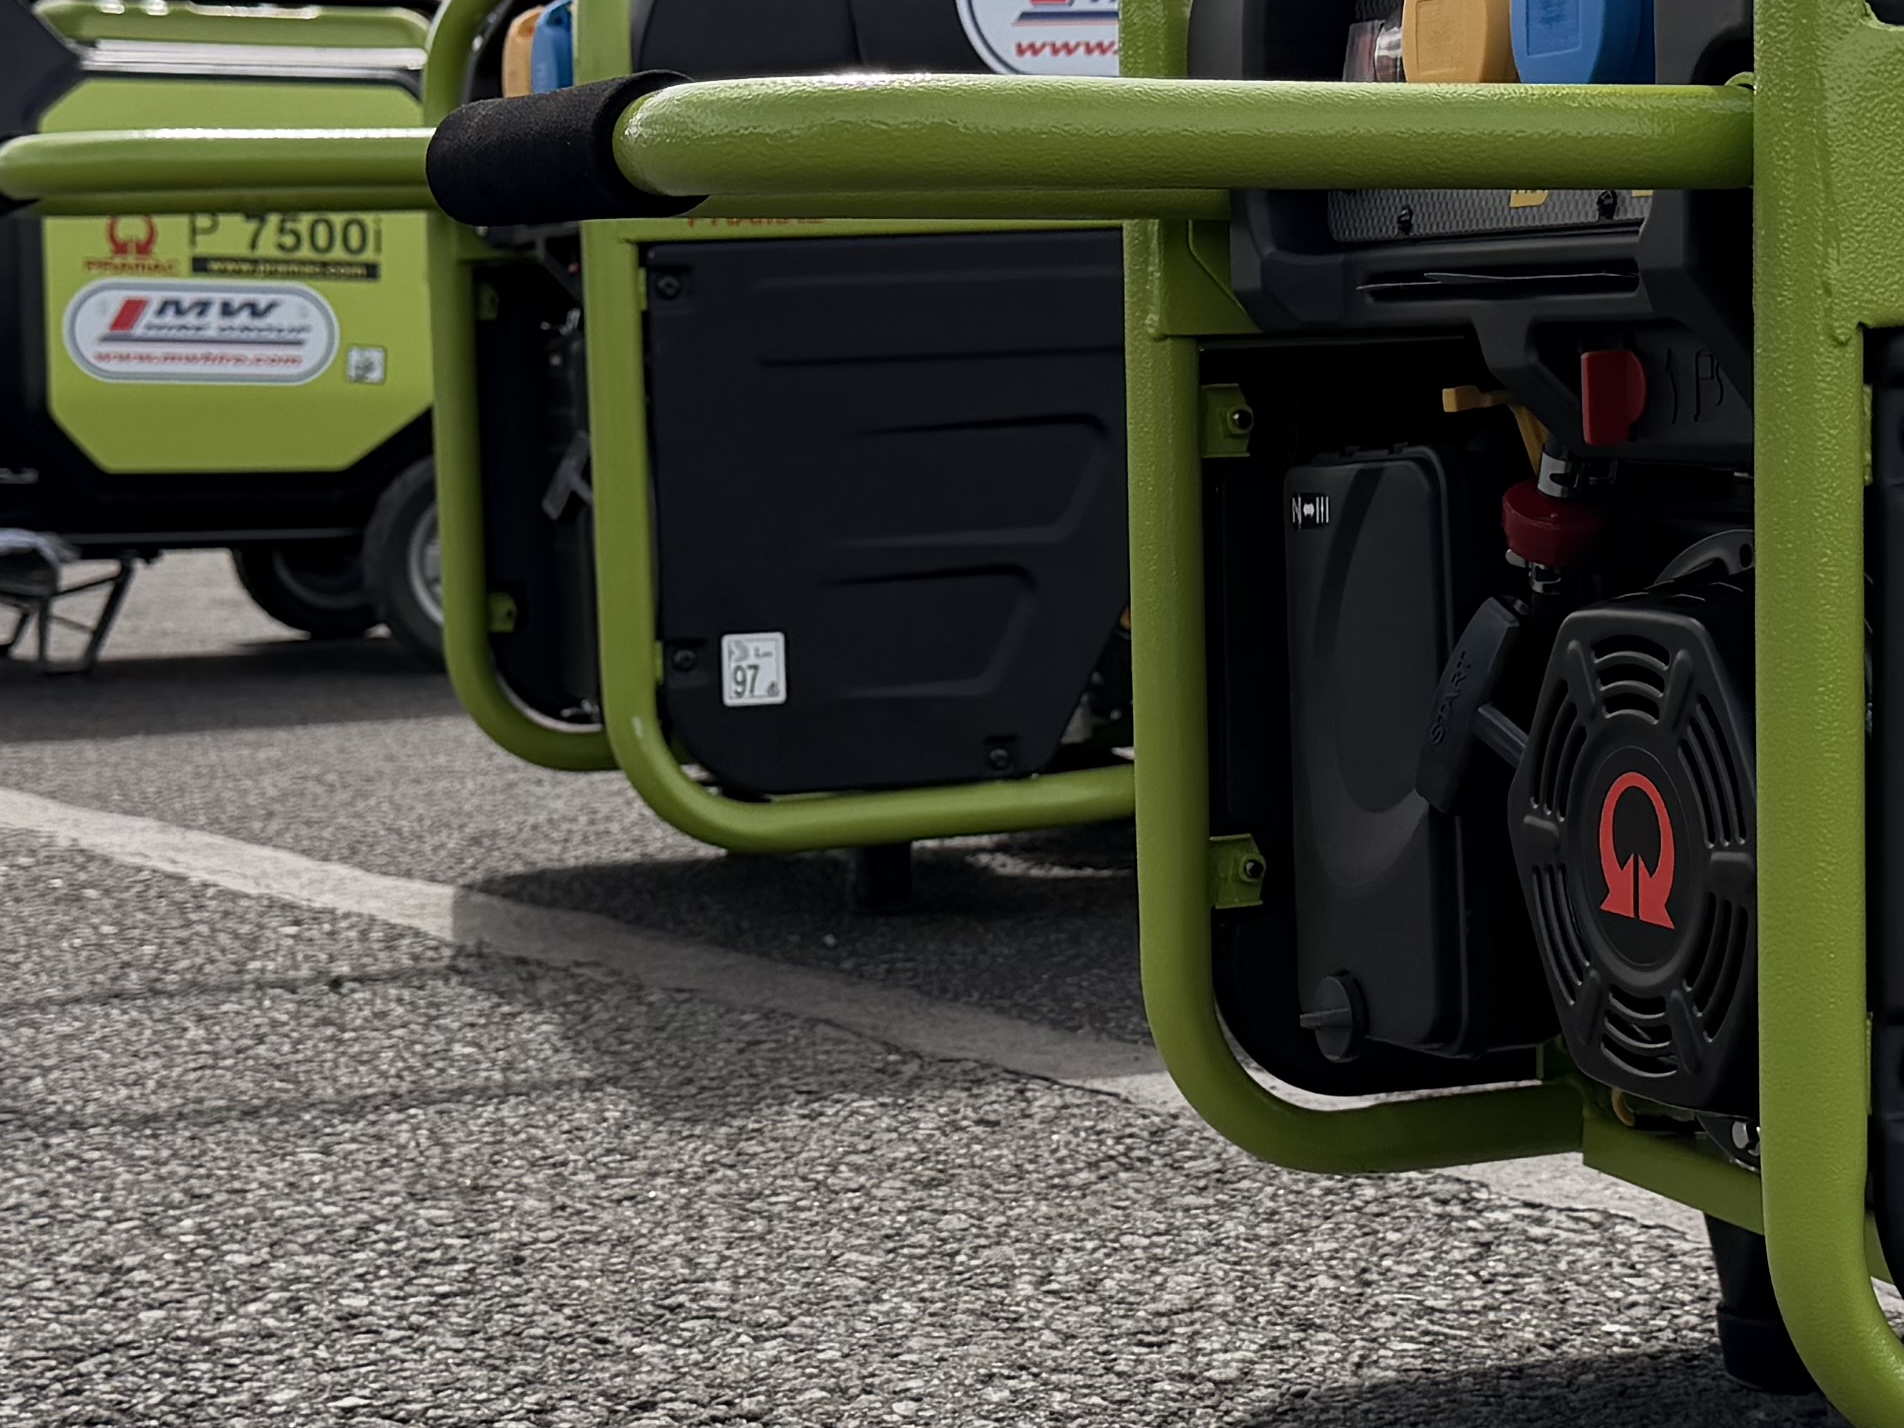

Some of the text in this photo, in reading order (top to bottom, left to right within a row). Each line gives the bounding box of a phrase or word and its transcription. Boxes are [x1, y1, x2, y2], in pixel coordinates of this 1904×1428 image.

[190, 213, 219, 247] P
[156, 298, 280, 317] MW
[733, 664, 760, 699] 97
